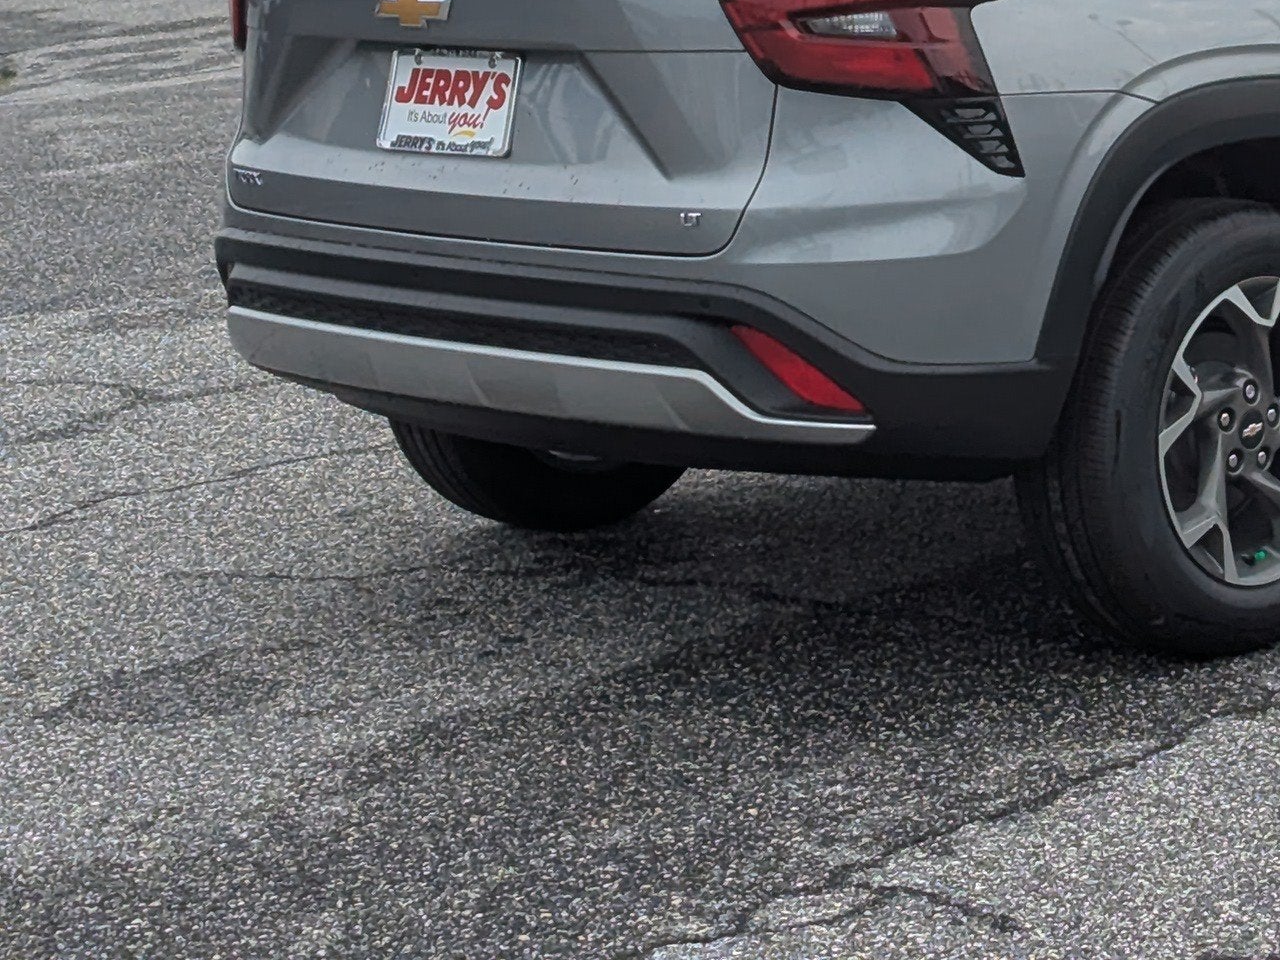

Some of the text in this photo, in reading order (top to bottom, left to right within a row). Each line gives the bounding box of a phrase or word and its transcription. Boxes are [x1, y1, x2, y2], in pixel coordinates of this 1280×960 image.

[395, 68, 511, 110] JERRY'S
[408, 107, 491, 135] It's About you!
[389, 134, 434, 151] JERRY'S
[680, 212, 701, 227] LT
